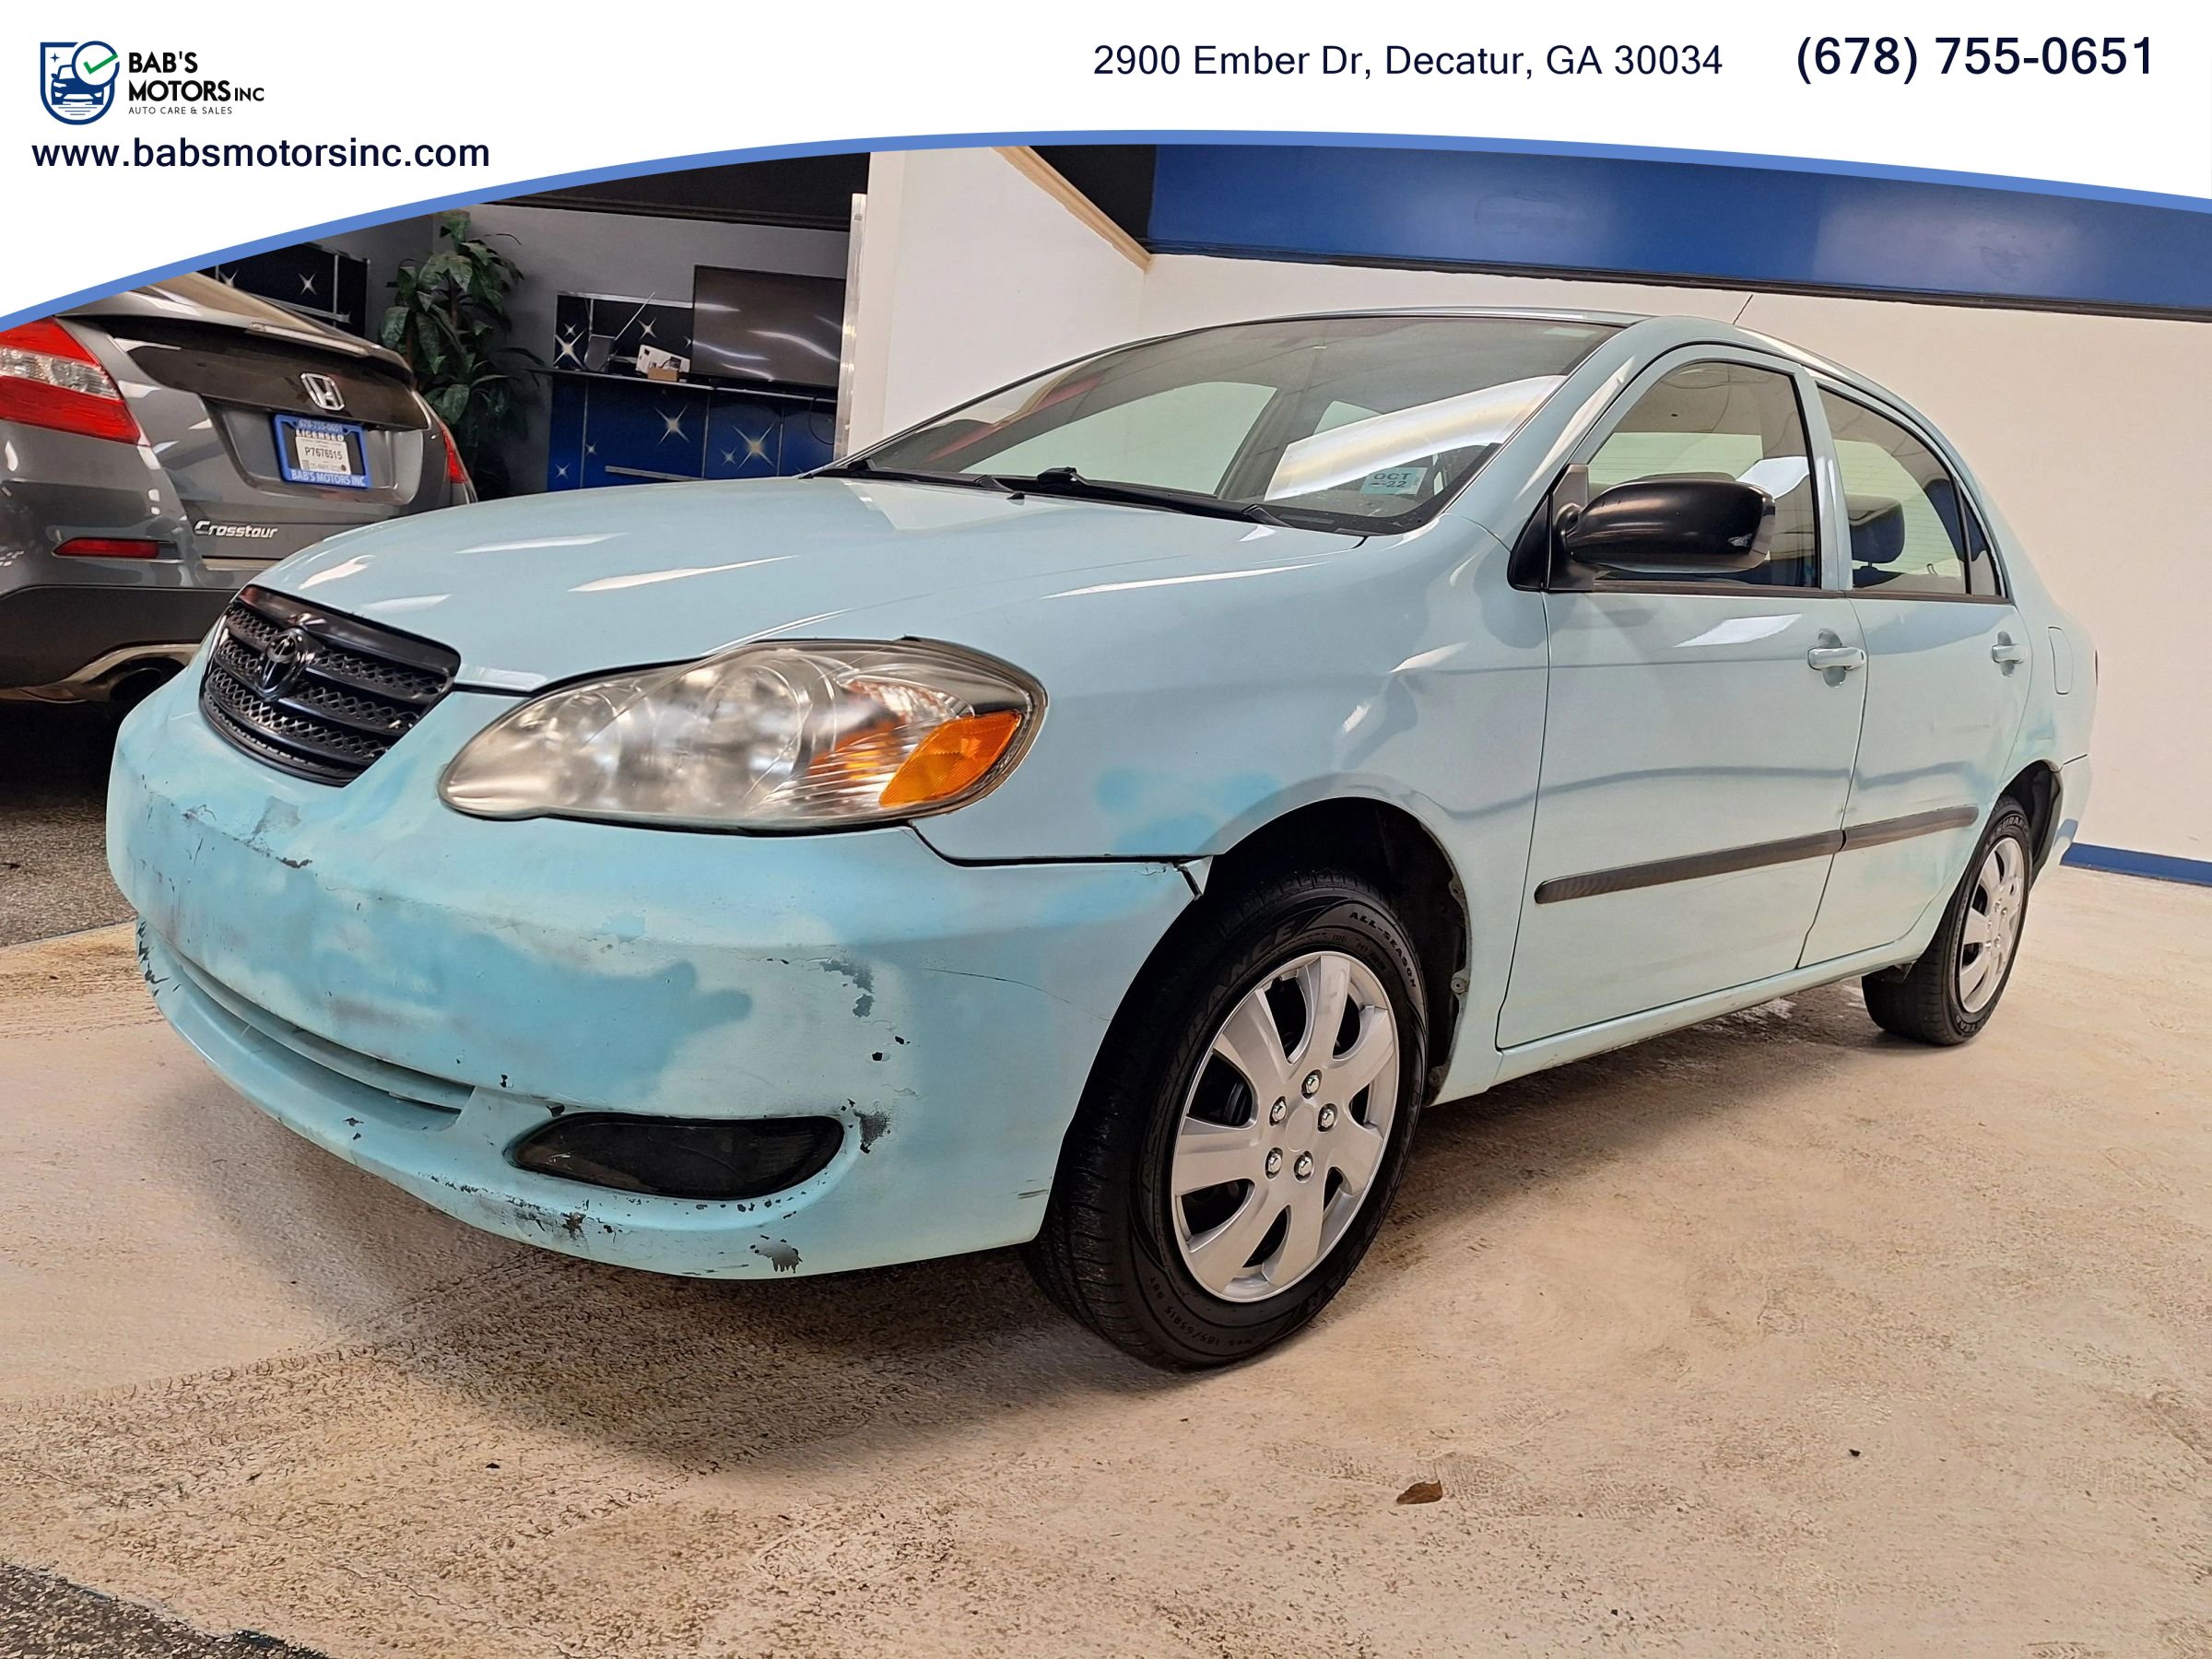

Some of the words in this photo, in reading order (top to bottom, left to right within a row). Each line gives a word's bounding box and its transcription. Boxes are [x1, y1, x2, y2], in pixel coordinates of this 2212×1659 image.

[296, 429, 345, 441] LICENSED
[305, 447, 342, 460] P7676515
[290, 470, 315, 481] BAB'S
[316, 473, 351, 485] MOTORS
[352, 476, 366, 486] INC
[194, 521, 278, 538] Crosstour
[1349, 912, 1417, 987] ALL-SEASON
